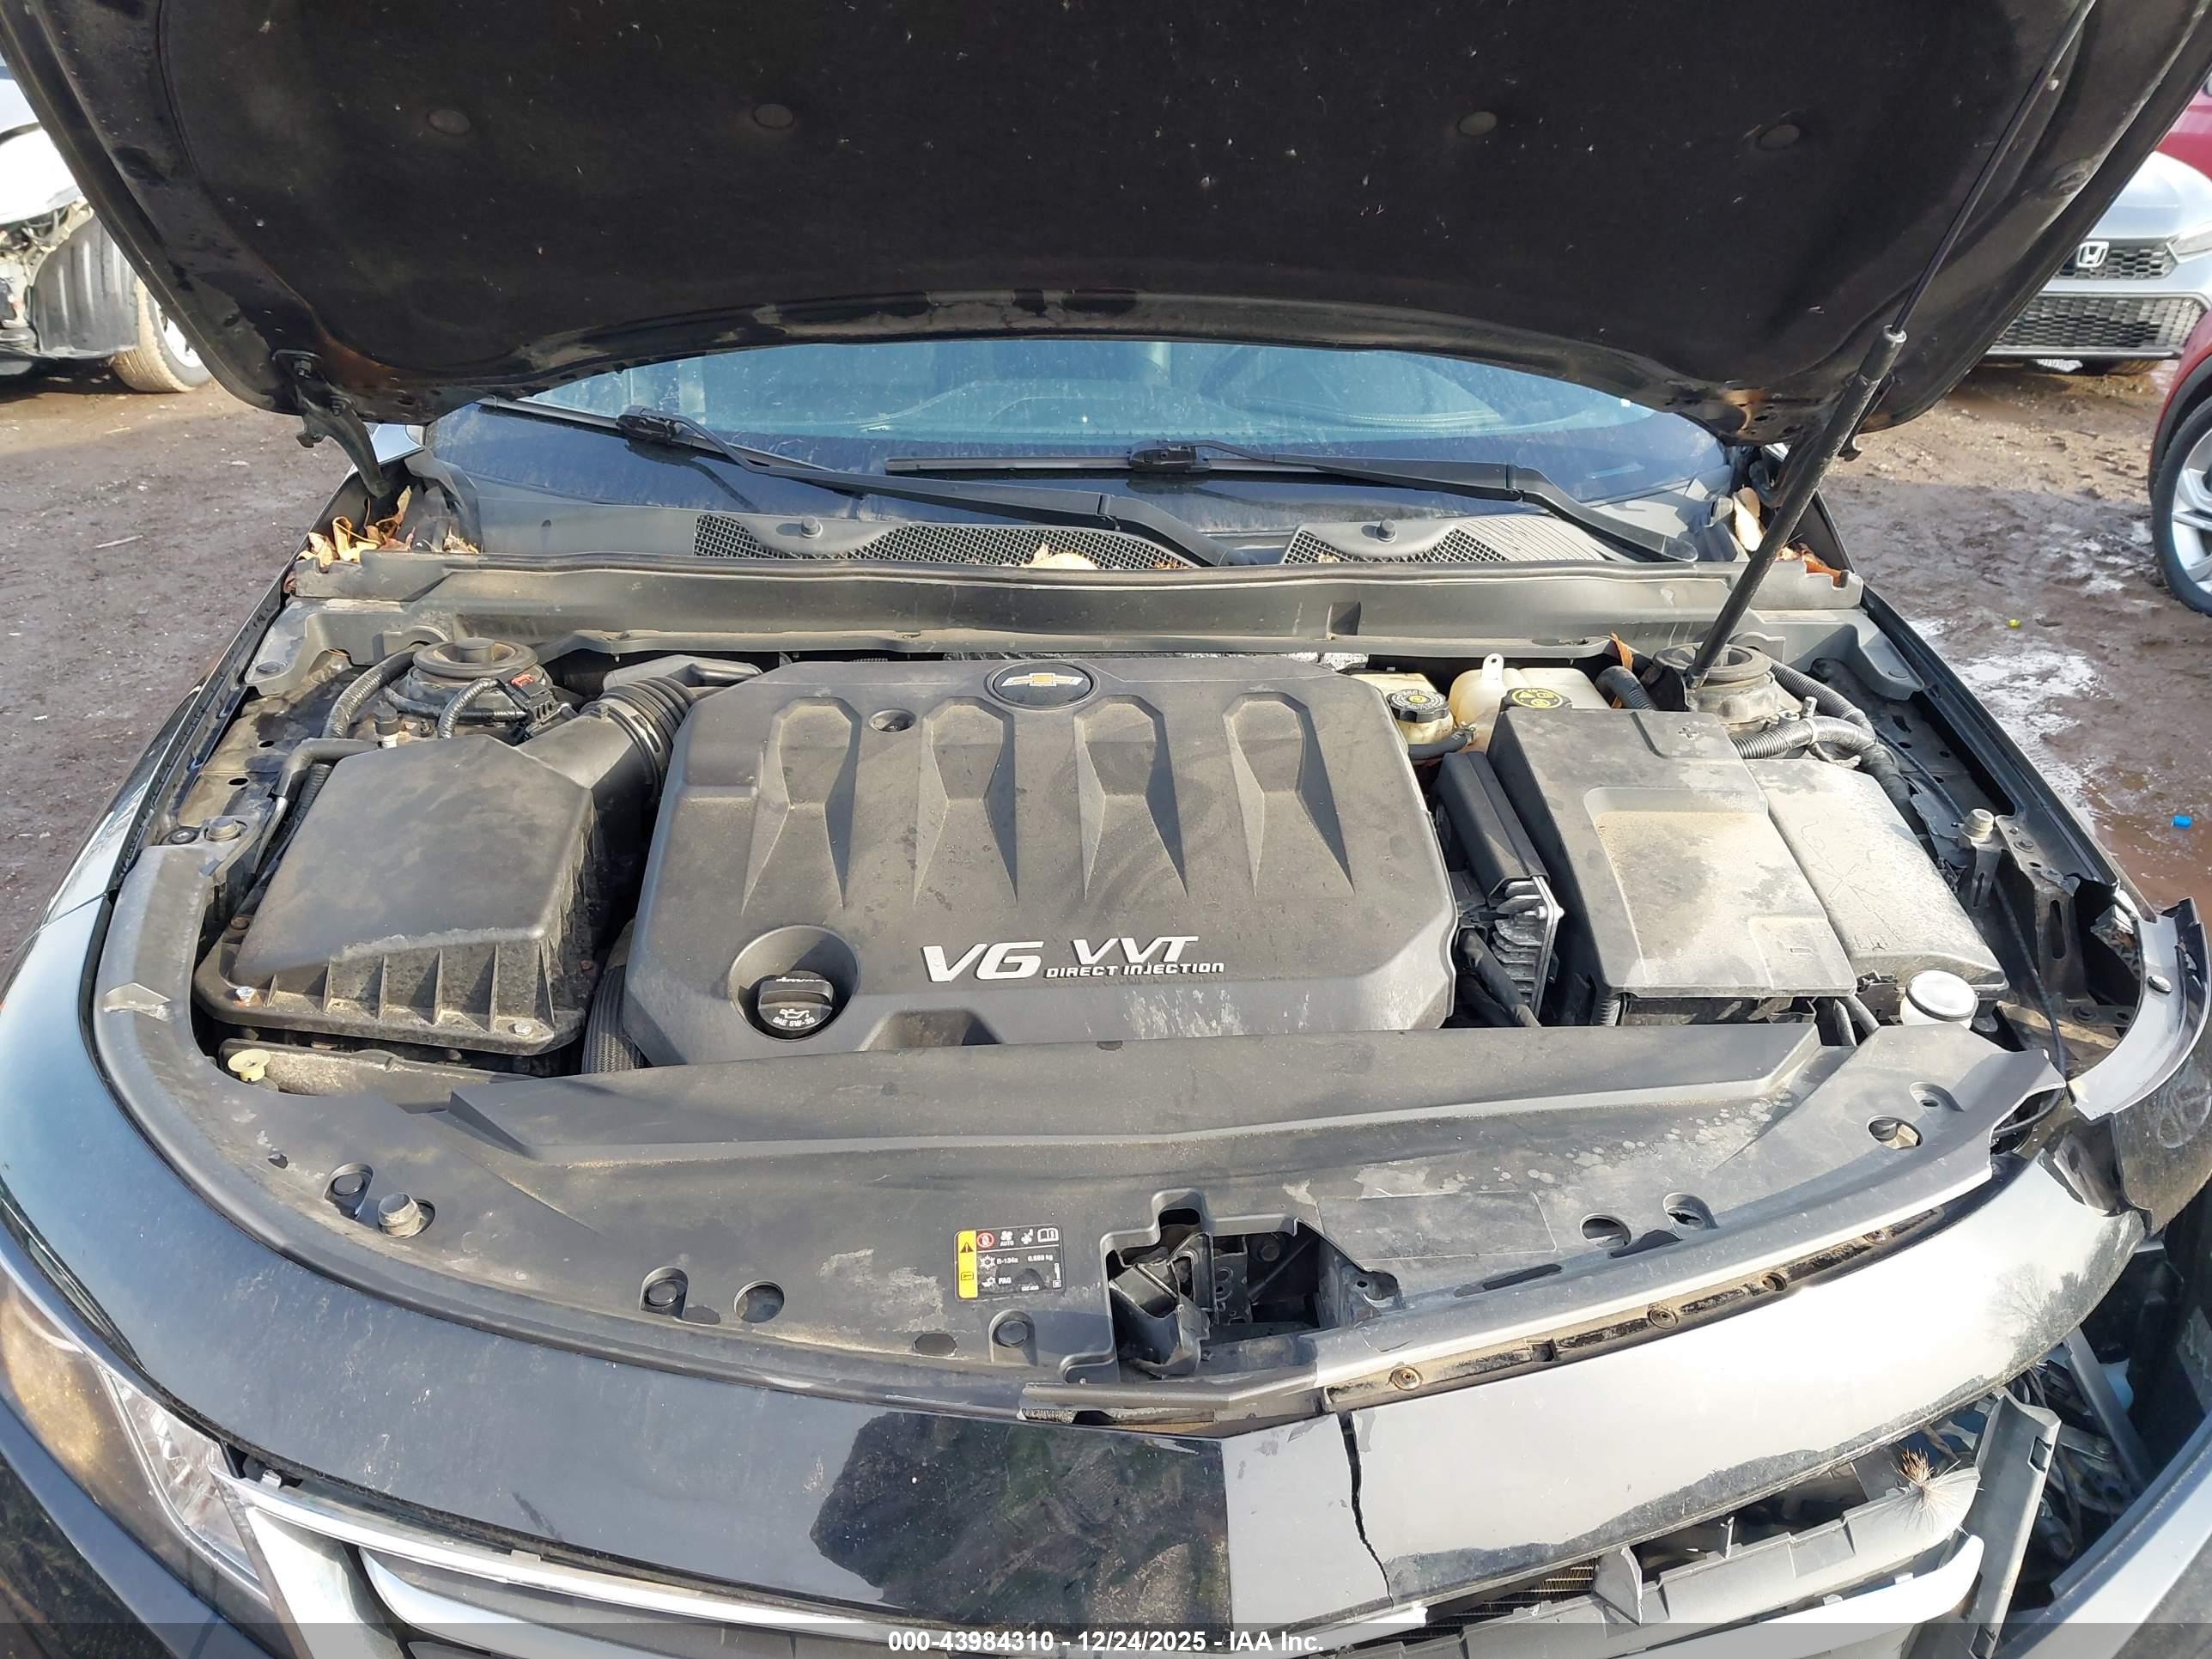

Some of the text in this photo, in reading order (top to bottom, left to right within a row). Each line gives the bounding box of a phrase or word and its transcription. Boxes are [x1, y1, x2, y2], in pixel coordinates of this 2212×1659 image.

[922, 942, 1044, 982] V6
[1073, 936, 1200, 965] VVT
[1046, 965, 1119, 978] DIRECT
